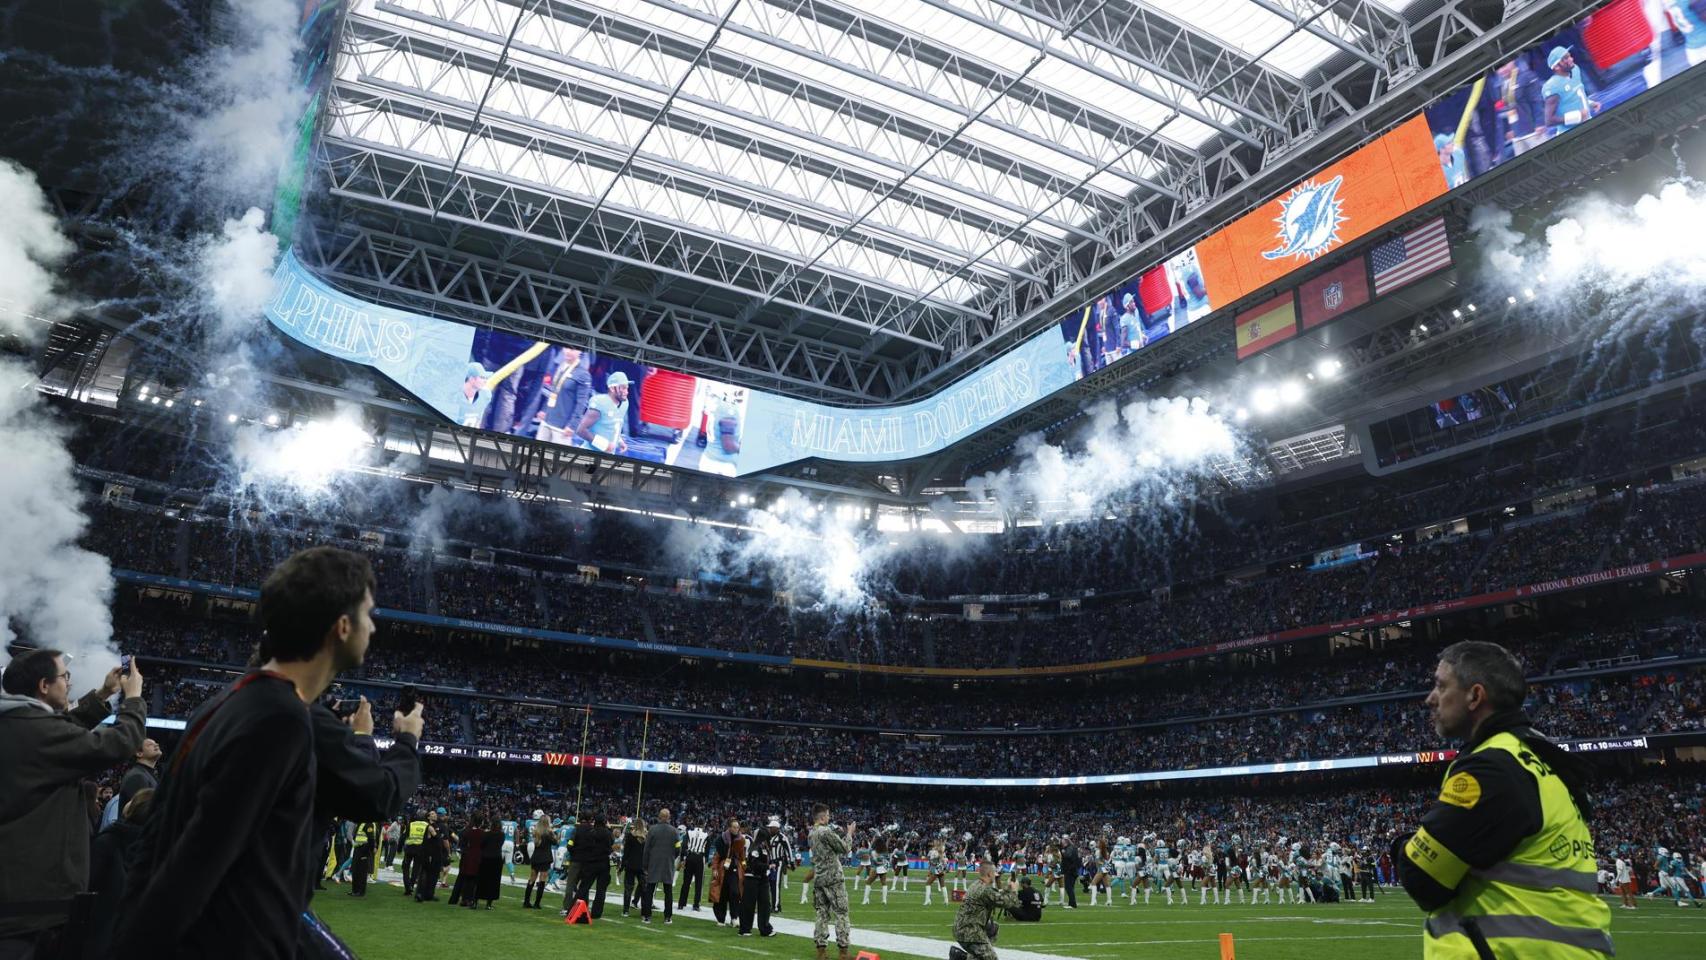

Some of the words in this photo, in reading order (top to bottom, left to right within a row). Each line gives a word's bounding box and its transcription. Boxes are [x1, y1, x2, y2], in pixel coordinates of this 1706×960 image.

[791, 409, 905, 455] MIAMI
[914, 358, 1032, 448] DOLPHINS
[1530, 581, 1571, 594] NATIONAL
[1571, 573, 1614, 586] FOOTBALL
[1616, 564, 1650, 577] LEAGUE
[484, 624, 507, 632] MADRID
[1578, 743, 1592, 751] 1ST
[1598, 742, 1608, 750] 10
[1632, 739, 1643, 747] 35
[425, 745, 445, 754] 9:23
[477, 749, 492, 758] 1ST
[496, 751, 507, 759] 10
[531, 754, 542, 762] 35
[1388, 755, 1412, 763] NetApp
[1438, 752, 1445, 761] 0
[572, 756, 579, 765] 0
[696, 764, 728, 776] NetApp
[502, 825, 514, 837] 79
